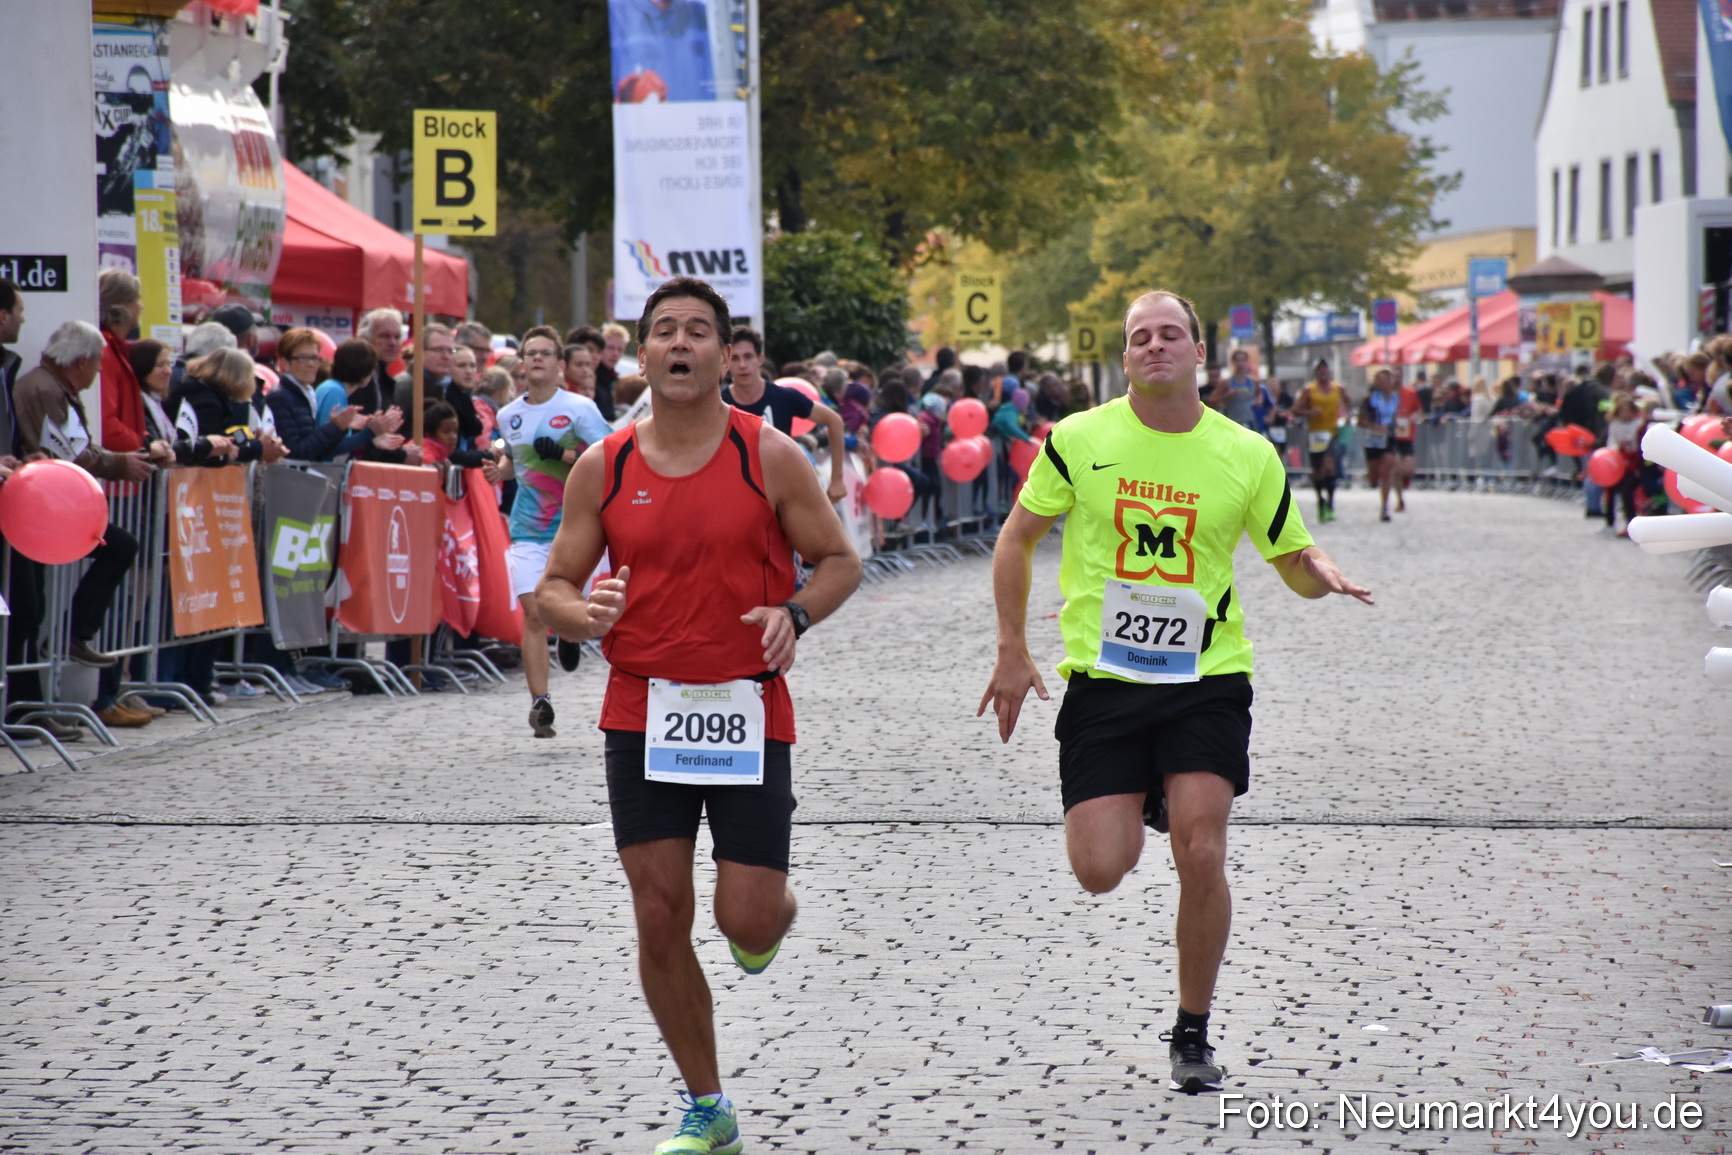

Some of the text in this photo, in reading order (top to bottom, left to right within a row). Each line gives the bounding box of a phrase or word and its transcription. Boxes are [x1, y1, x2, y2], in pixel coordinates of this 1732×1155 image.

[424, 115, 487, 139] Block
[436, 149, 476, 208] B
[140, 209, 164, 233] 18.
[967, 291, 989, 325] C
[1078, 327, 1096, 351] D
[1578, 315, 1597, 340] D
[1116, 477, 1200, 505] Müller
[1135, 523, 1177, 558] M
[1140, 594, 1177, 605] BOCK
[1115, 611, 1188, 647] 2372
[1127, 651, 1168, 667] Dominik
[691, 689, 731, 699] BOCK
[664, 712, 746, 744] 2098
[675, 753, 733, 767] Ferdinand
